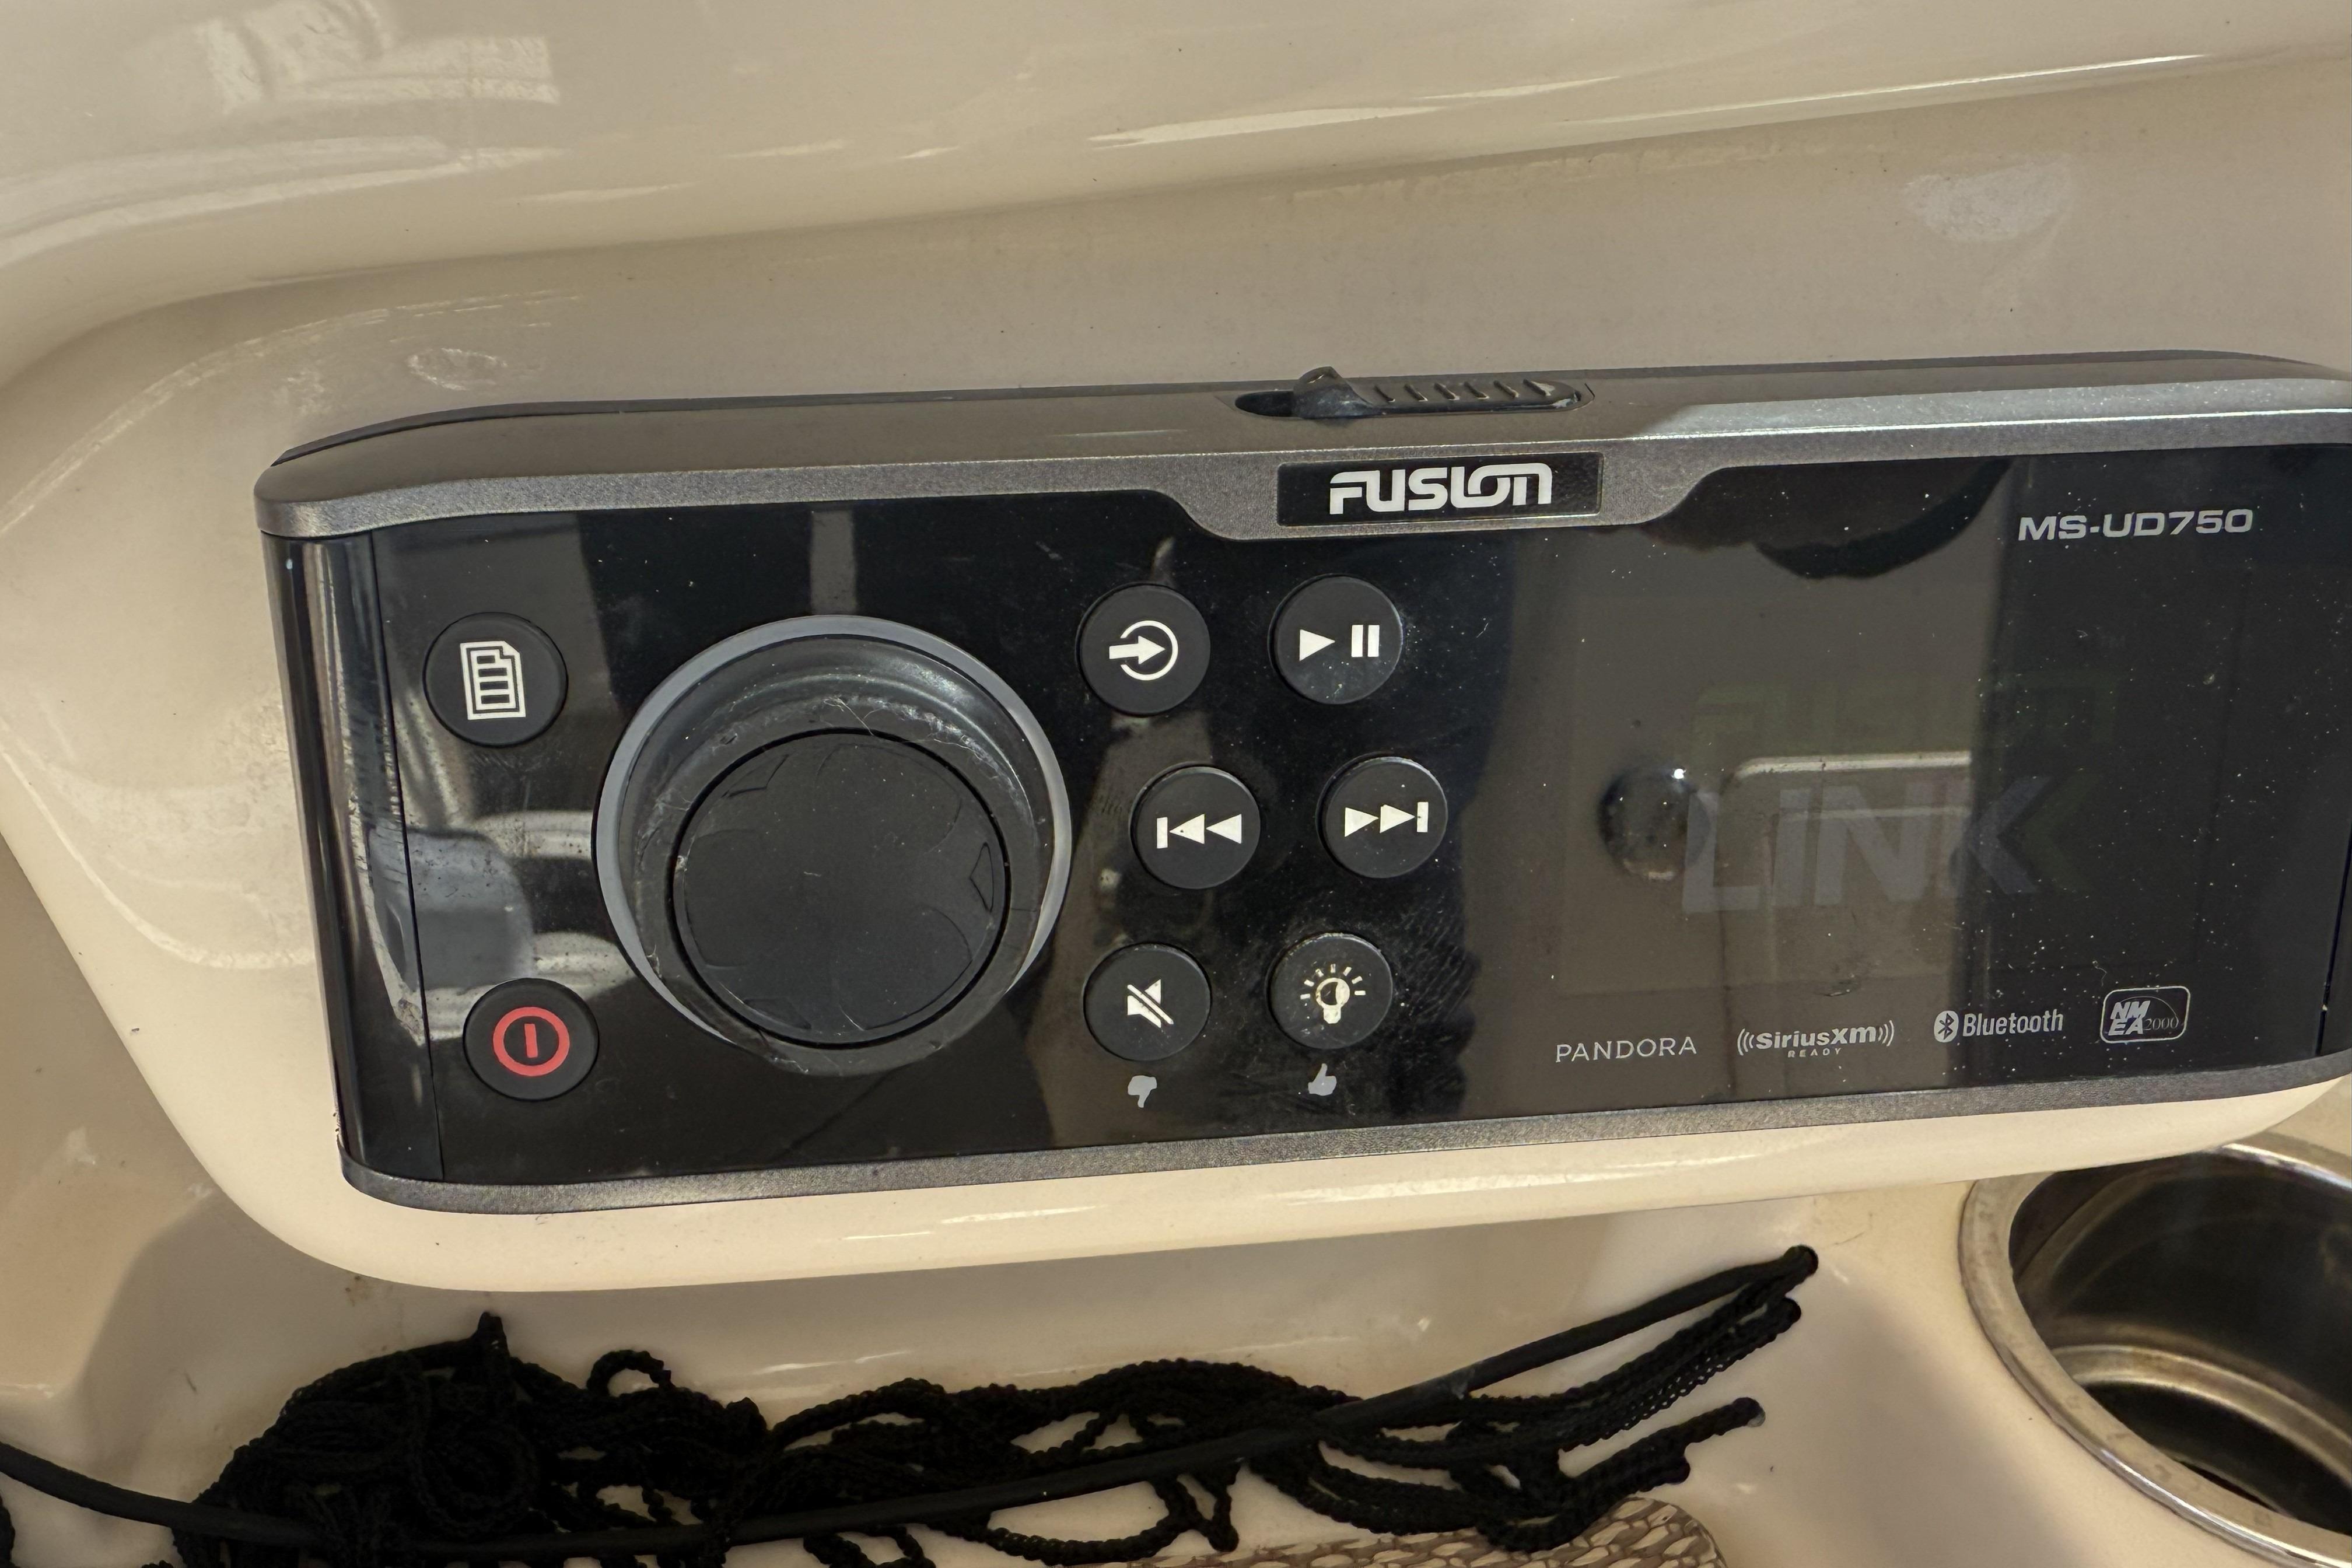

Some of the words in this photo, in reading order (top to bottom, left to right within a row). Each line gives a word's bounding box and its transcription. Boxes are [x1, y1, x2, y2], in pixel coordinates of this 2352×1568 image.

[1329, 463, 1553, 515] FUSION
[2018, 509, 2253, 541] MS-UD750
[1962, 1009, 2064, 1037] Bluetooth
[2143, 1016, 2179, 1031] 2000
[1555, 1036, 1697, 1063] PANDORA
[1787, 1048, 1842, 1058] READY
